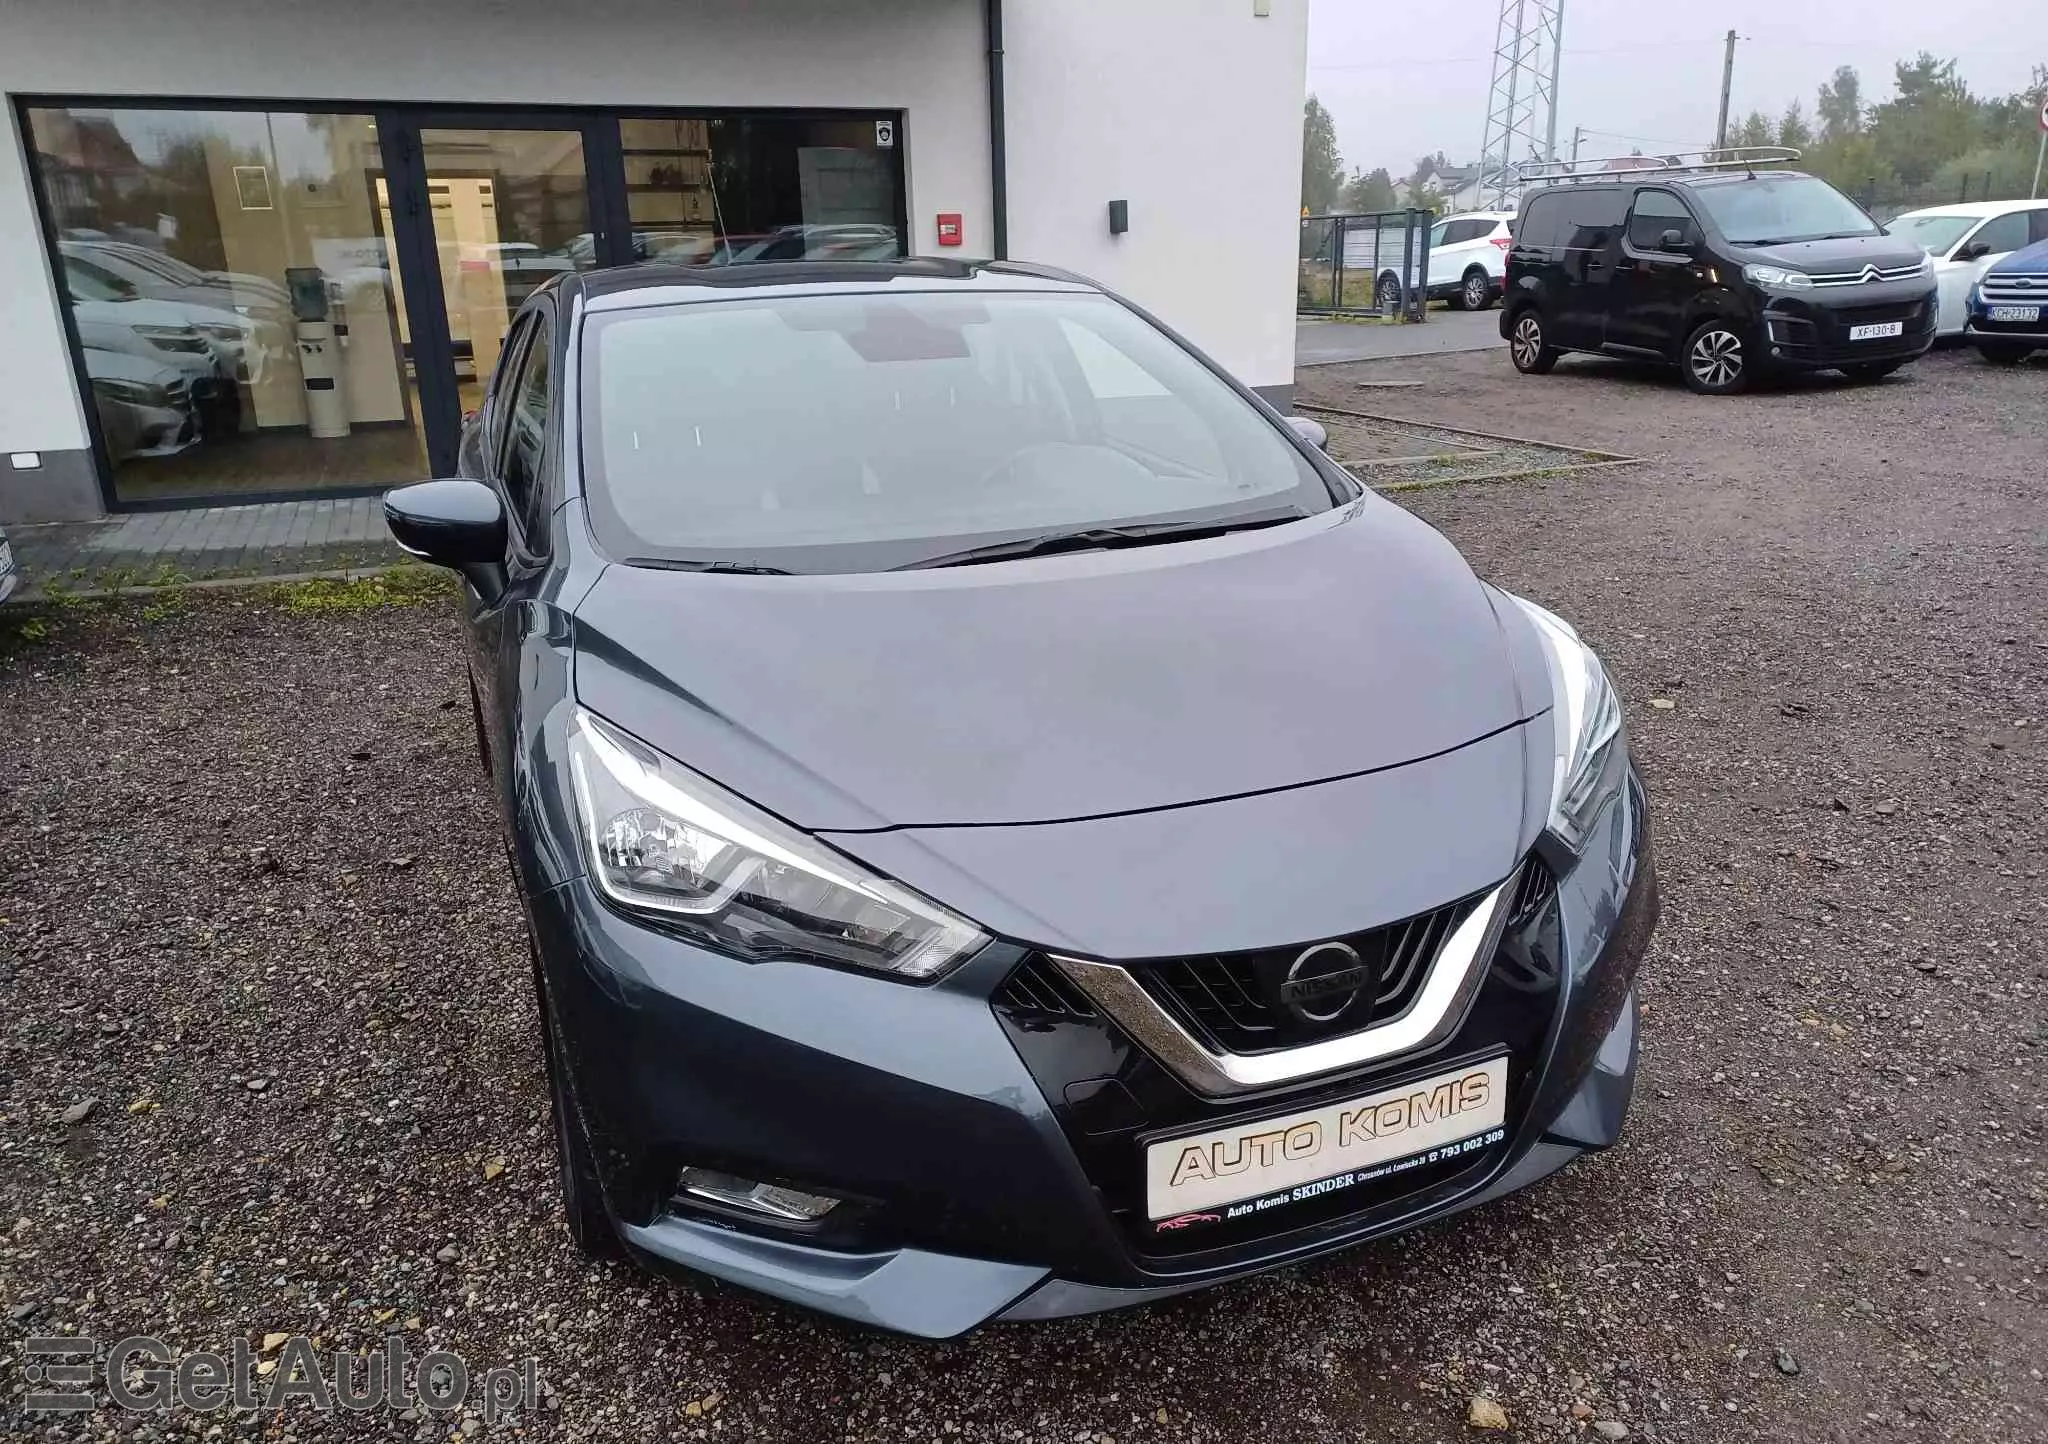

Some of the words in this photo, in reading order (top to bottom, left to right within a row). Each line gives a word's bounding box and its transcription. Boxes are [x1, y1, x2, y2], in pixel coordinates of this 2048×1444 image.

[1291, 969, 1362, 998] NISSAN
[1169, 1120, 1323, 1188] AUTO
[1339, 1072, 1491, 1148] KOMIS
[1227, 1204, 1254, 1219] Auto
[1256, 1193, 1290, 1211] Komis
[1292, 1173, 1355, 1201] SKINDER
[1440, 1144, 1461, 1159] 793
[1463, 1137, 1483, 1152] 002
[1485, 1129, 1504, 1145] 309
